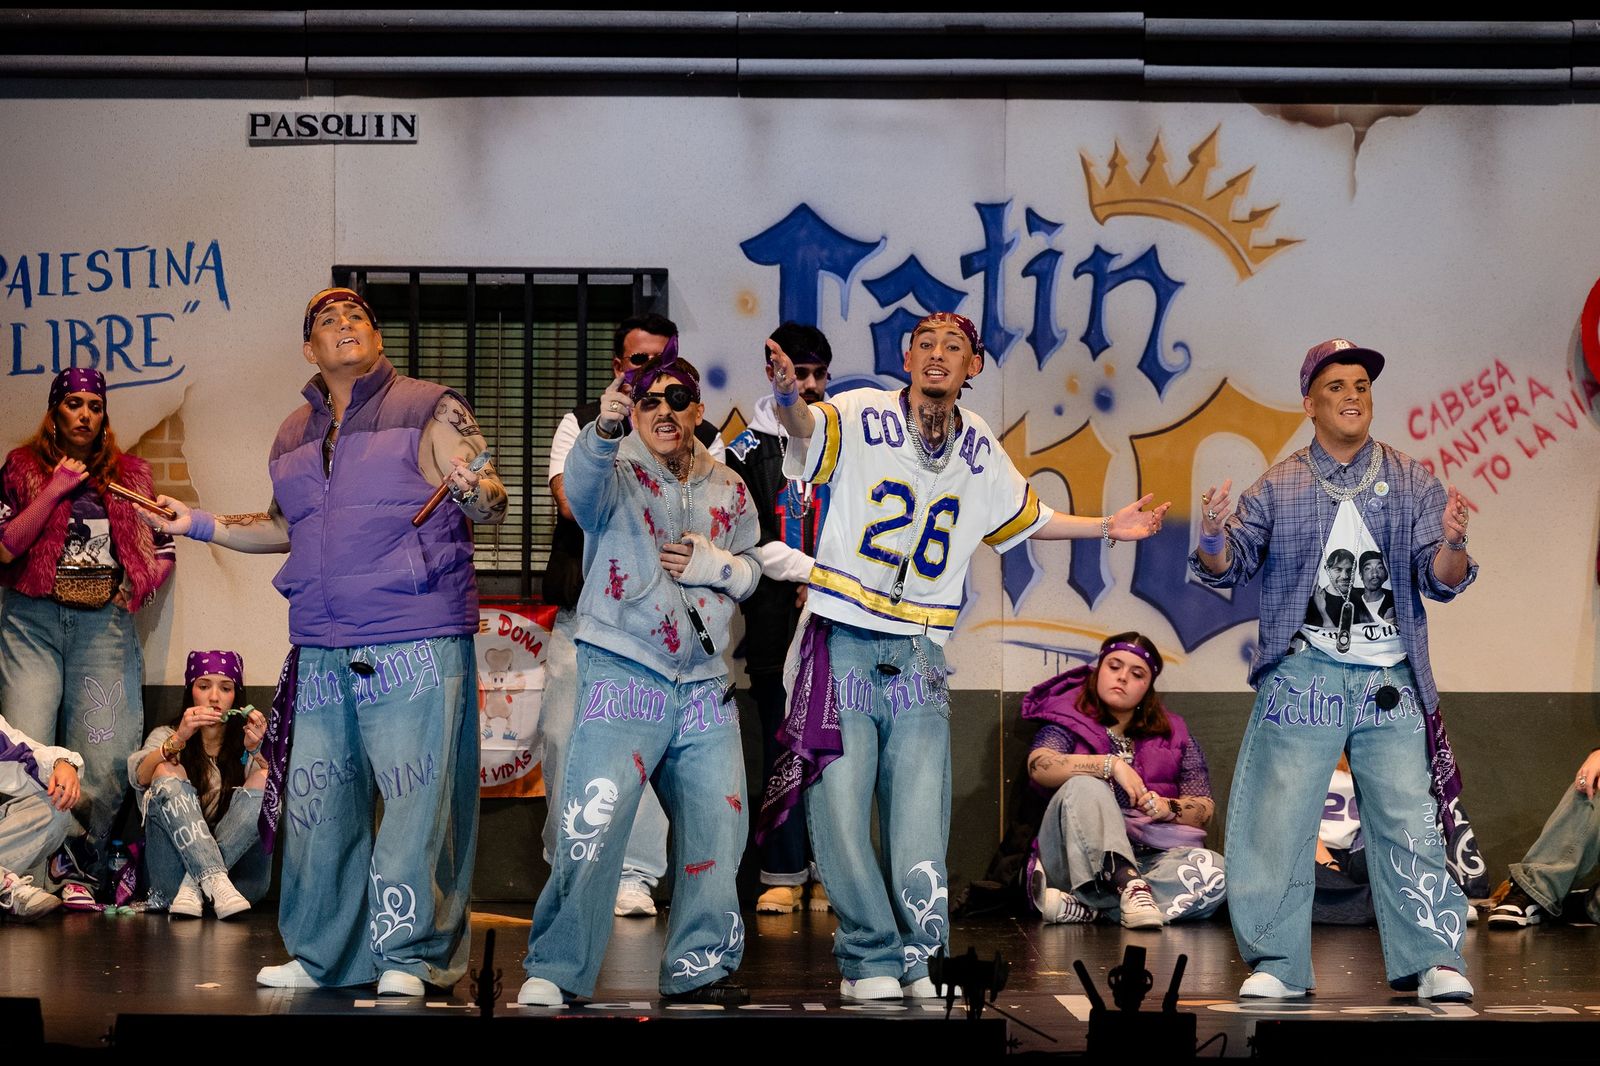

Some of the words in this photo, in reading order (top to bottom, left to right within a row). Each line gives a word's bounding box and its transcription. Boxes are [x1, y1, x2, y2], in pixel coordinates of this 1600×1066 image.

[249, 113, 416, 137] PASQUIN
[1407, 358, 1516, 440] CABESA
[1473, 454, 1511, 495] TO
[1515, 422, 1557, 459] LA
[856, 477, 960, 581] 26
[498, 614, 543, 658] DONA
[1260, 675, 1346, 729] Latin
[491, 750, 532, 782] VIDAS
[1207, 1002, 1600, 1018] Caja
